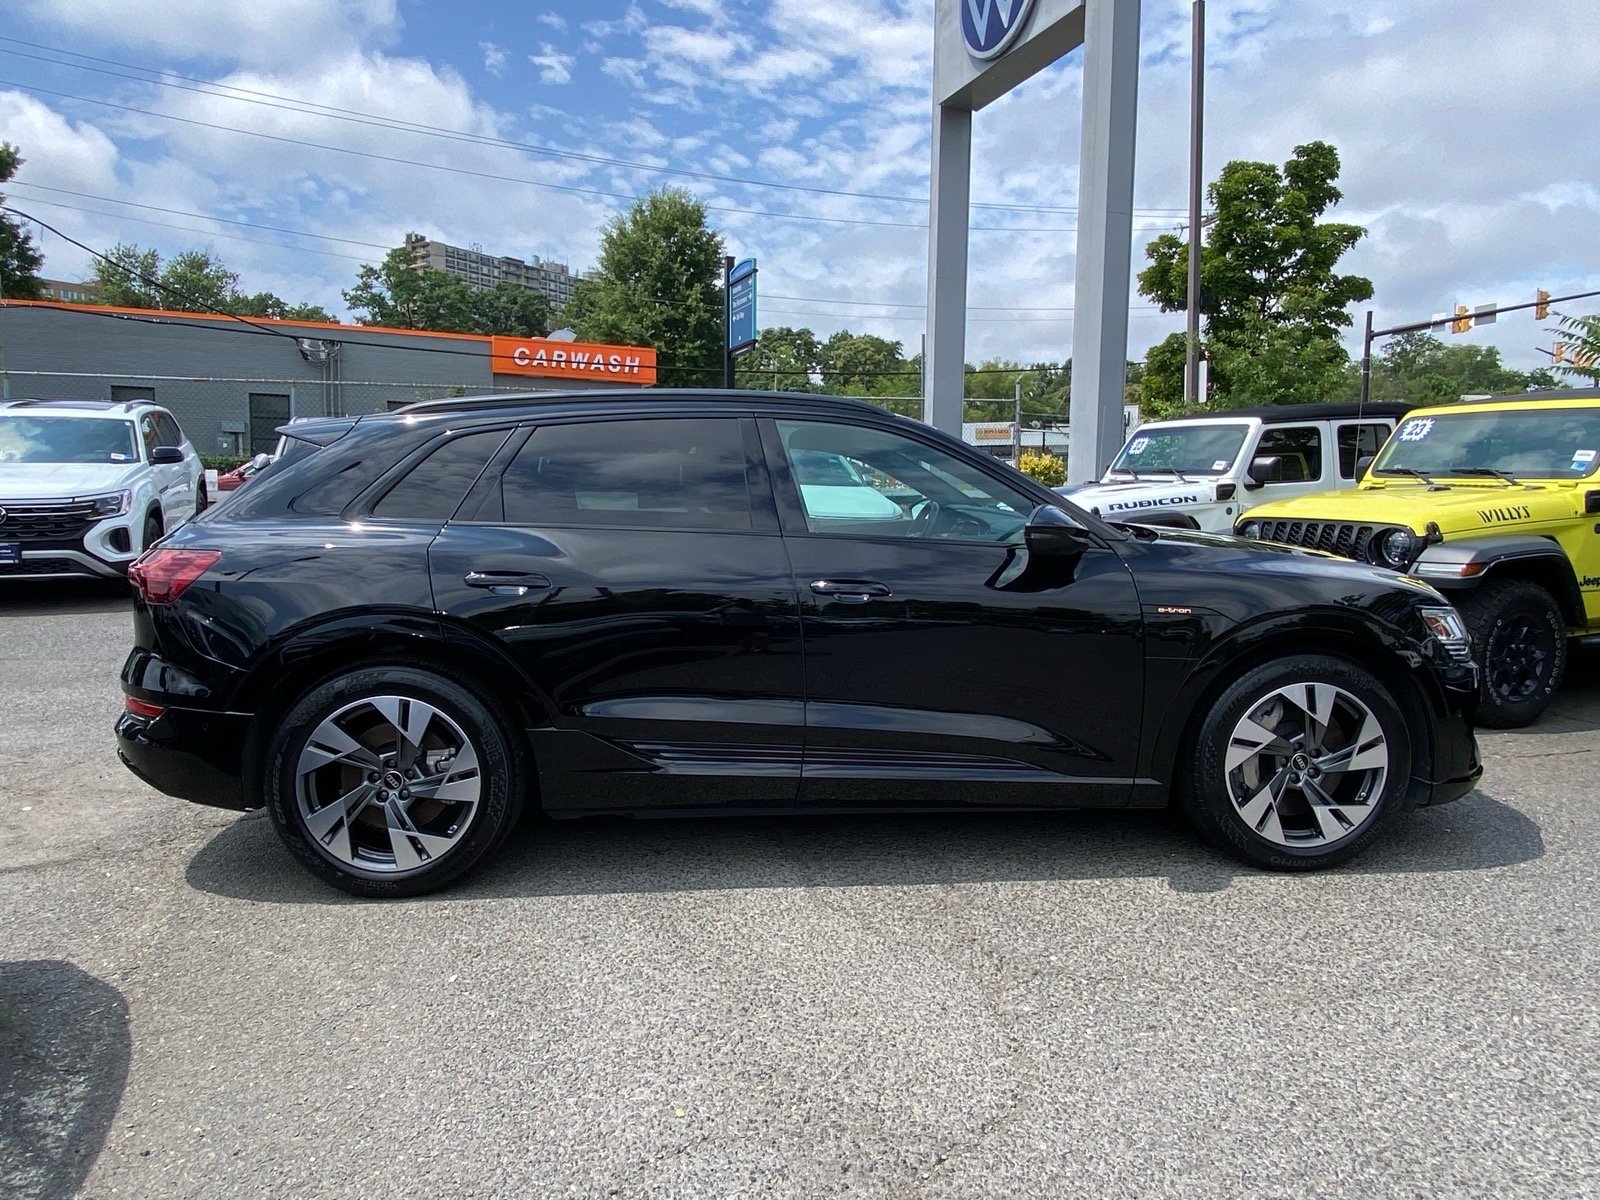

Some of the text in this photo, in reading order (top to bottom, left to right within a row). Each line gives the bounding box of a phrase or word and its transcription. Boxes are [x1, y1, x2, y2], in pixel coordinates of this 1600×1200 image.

[513, 347, 640, 374] CARWASH
[1405, 423, 1427, 436] 23
[1108, 495, 1198, 511] RUBICON
[1477, 505, 1531, 524] WILLYS
